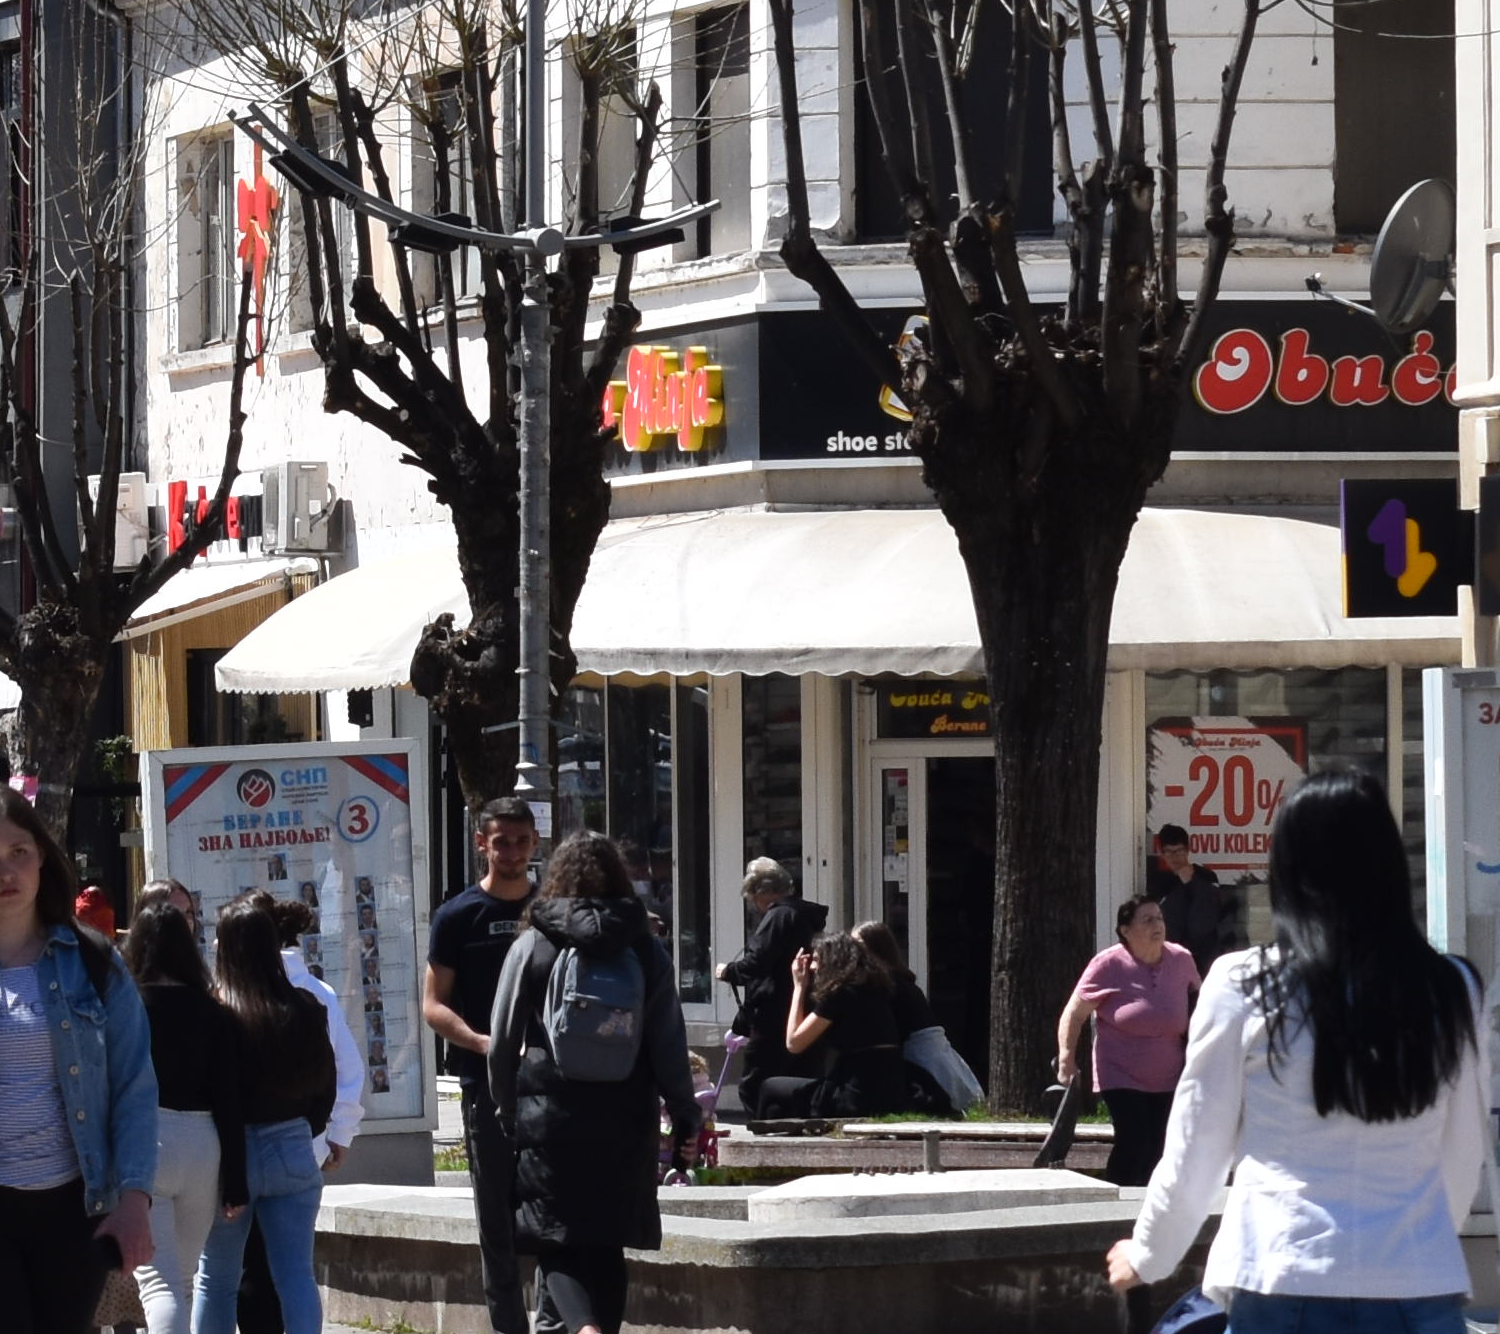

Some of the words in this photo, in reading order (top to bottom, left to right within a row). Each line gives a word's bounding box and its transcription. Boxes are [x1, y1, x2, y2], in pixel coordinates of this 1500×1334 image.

[826, 430, 878, 452] shoe
[280, 767, 328, 786] СНП
[1164, 754, 1284, 827] -20%
[348, 803, 369, 835] 3
[199, 834, 234, 852] ЗНА
[1189, 833, 1220, 854] OVU
